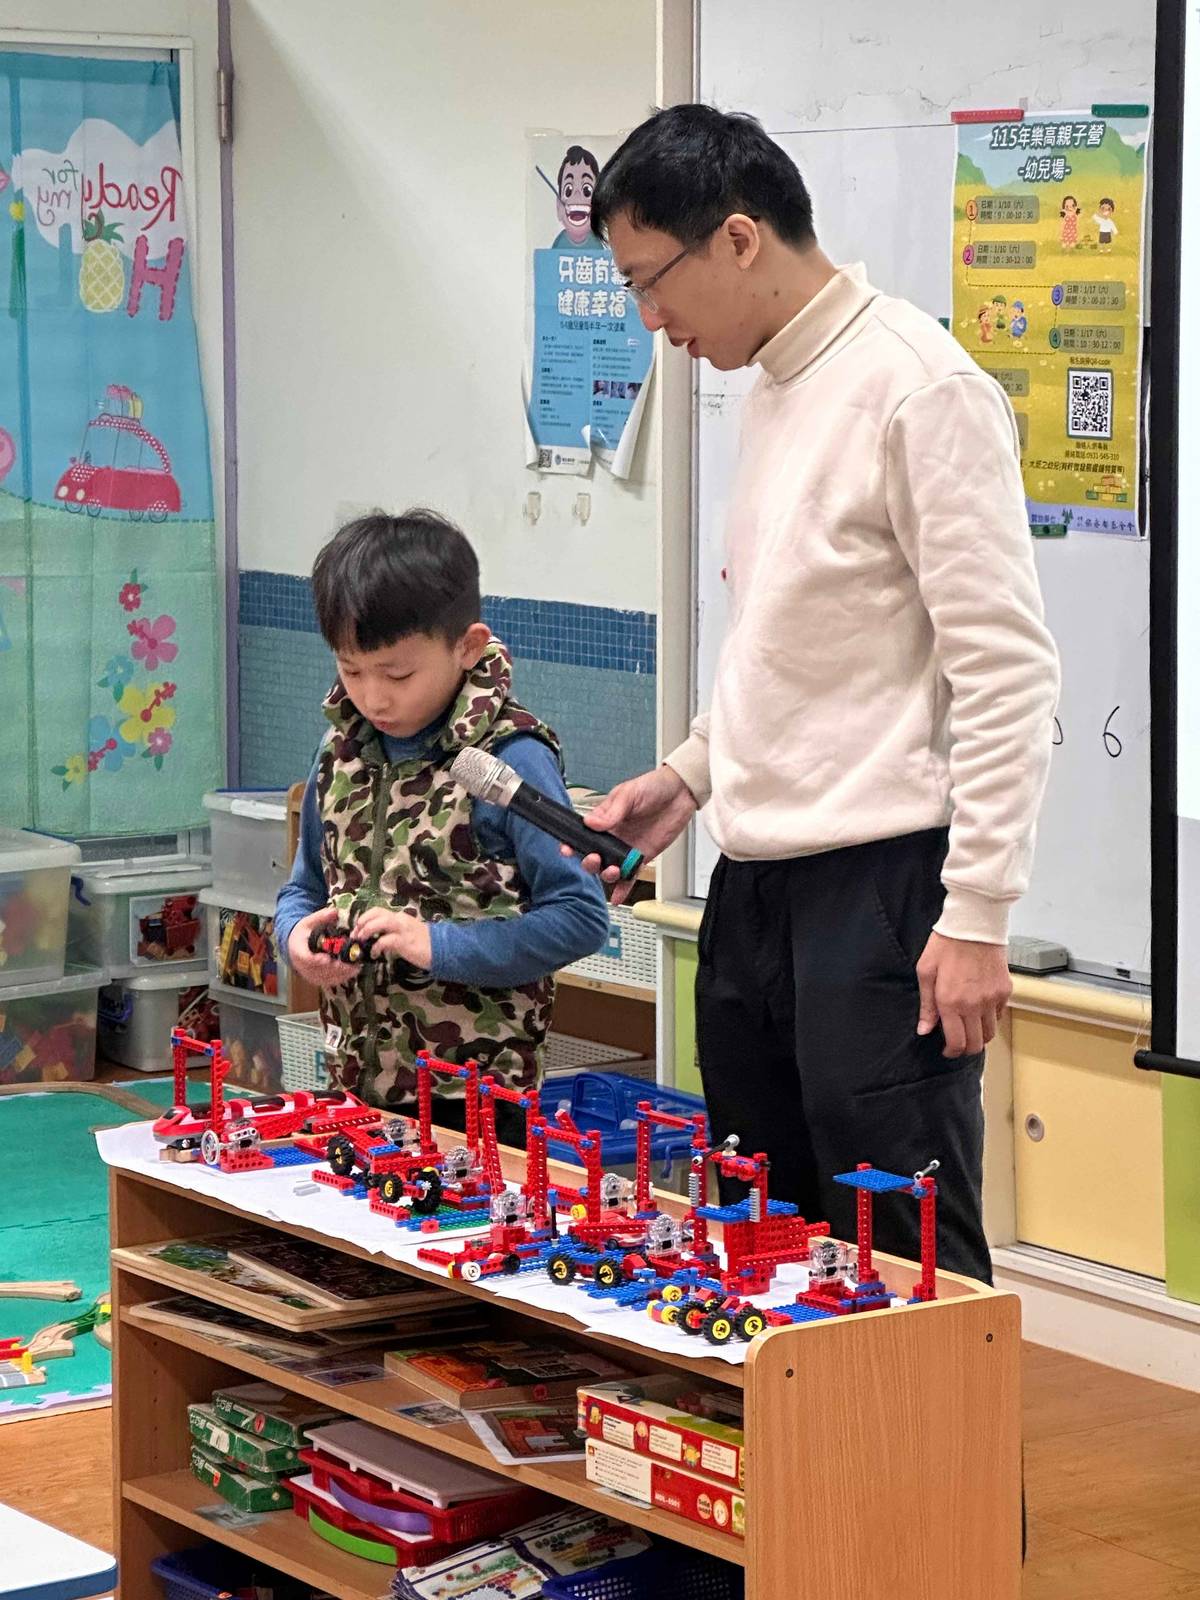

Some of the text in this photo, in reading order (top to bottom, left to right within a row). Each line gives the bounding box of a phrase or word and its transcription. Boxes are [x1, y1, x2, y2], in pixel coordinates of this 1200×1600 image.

[991, 124, 1105, 148] 115年樂高親子營
[1019, 158, 1071, 180] -幼兒場-
[557, 288, 627, 318] 健康幸福
[1102, 705, 1122, 757] 6
